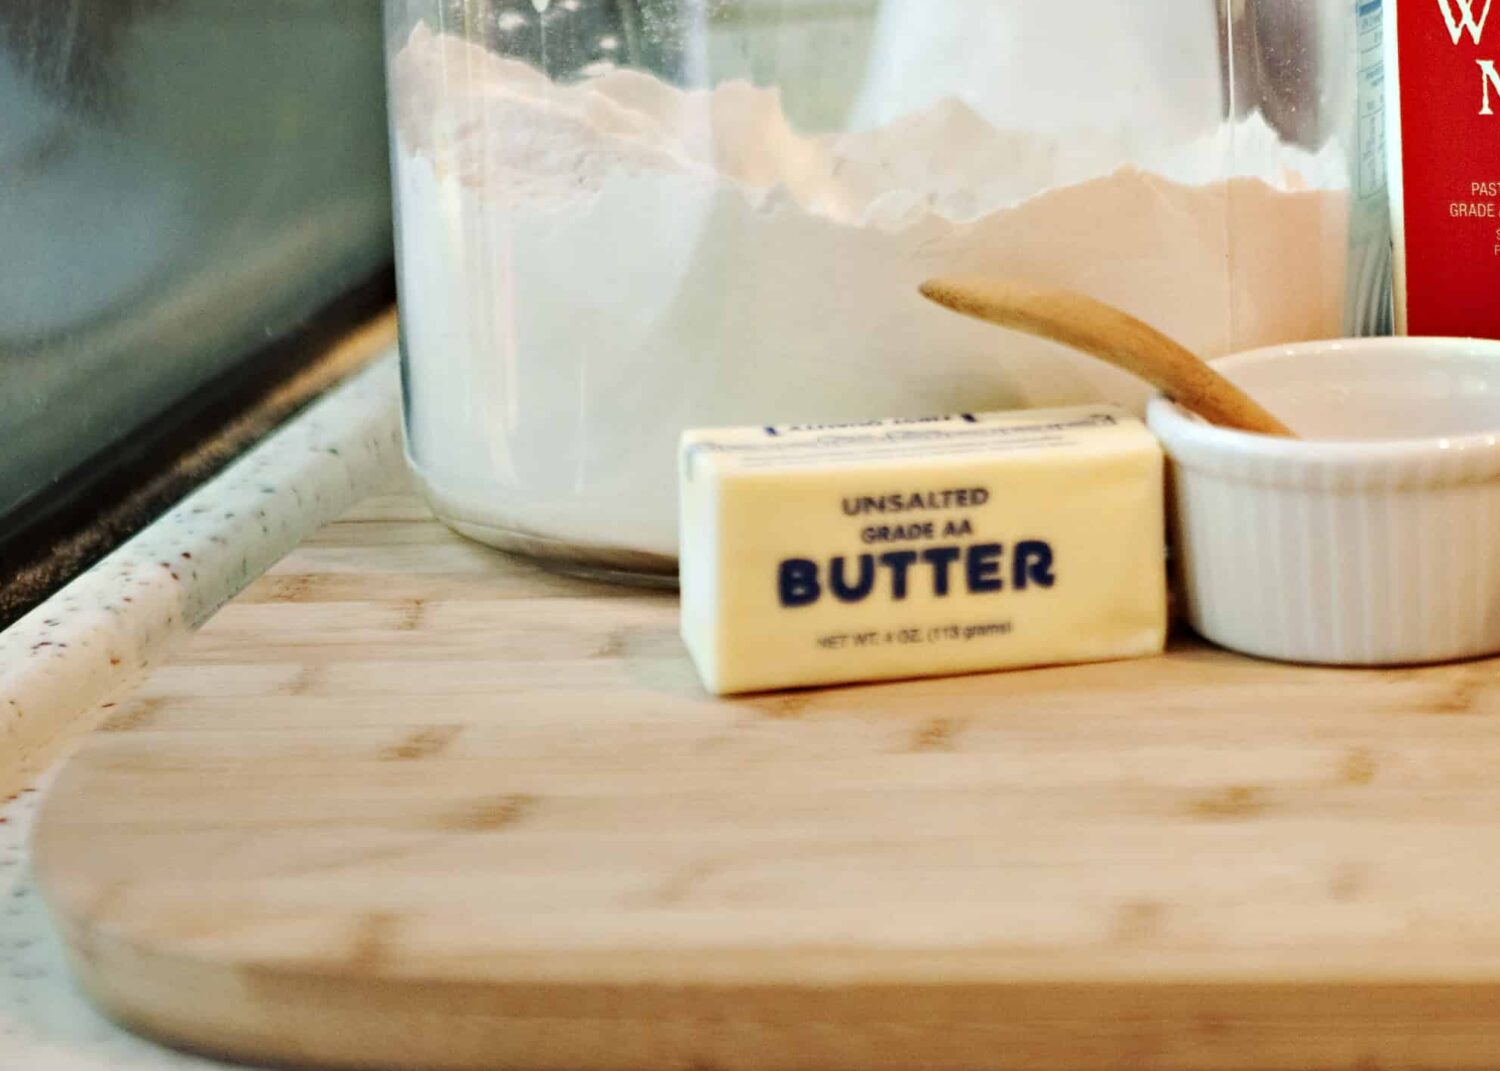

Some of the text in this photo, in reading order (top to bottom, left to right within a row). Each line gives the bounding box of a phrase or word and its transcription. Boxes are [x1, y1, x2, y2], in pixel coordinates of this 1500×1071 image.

[1450, 203, 1495, 218] GRADE
[841, 487, 990, 517] UNSALTED
[861, 519, 974, 544] GRADE AA
[776, 539, 1058, 609] BUTTER
